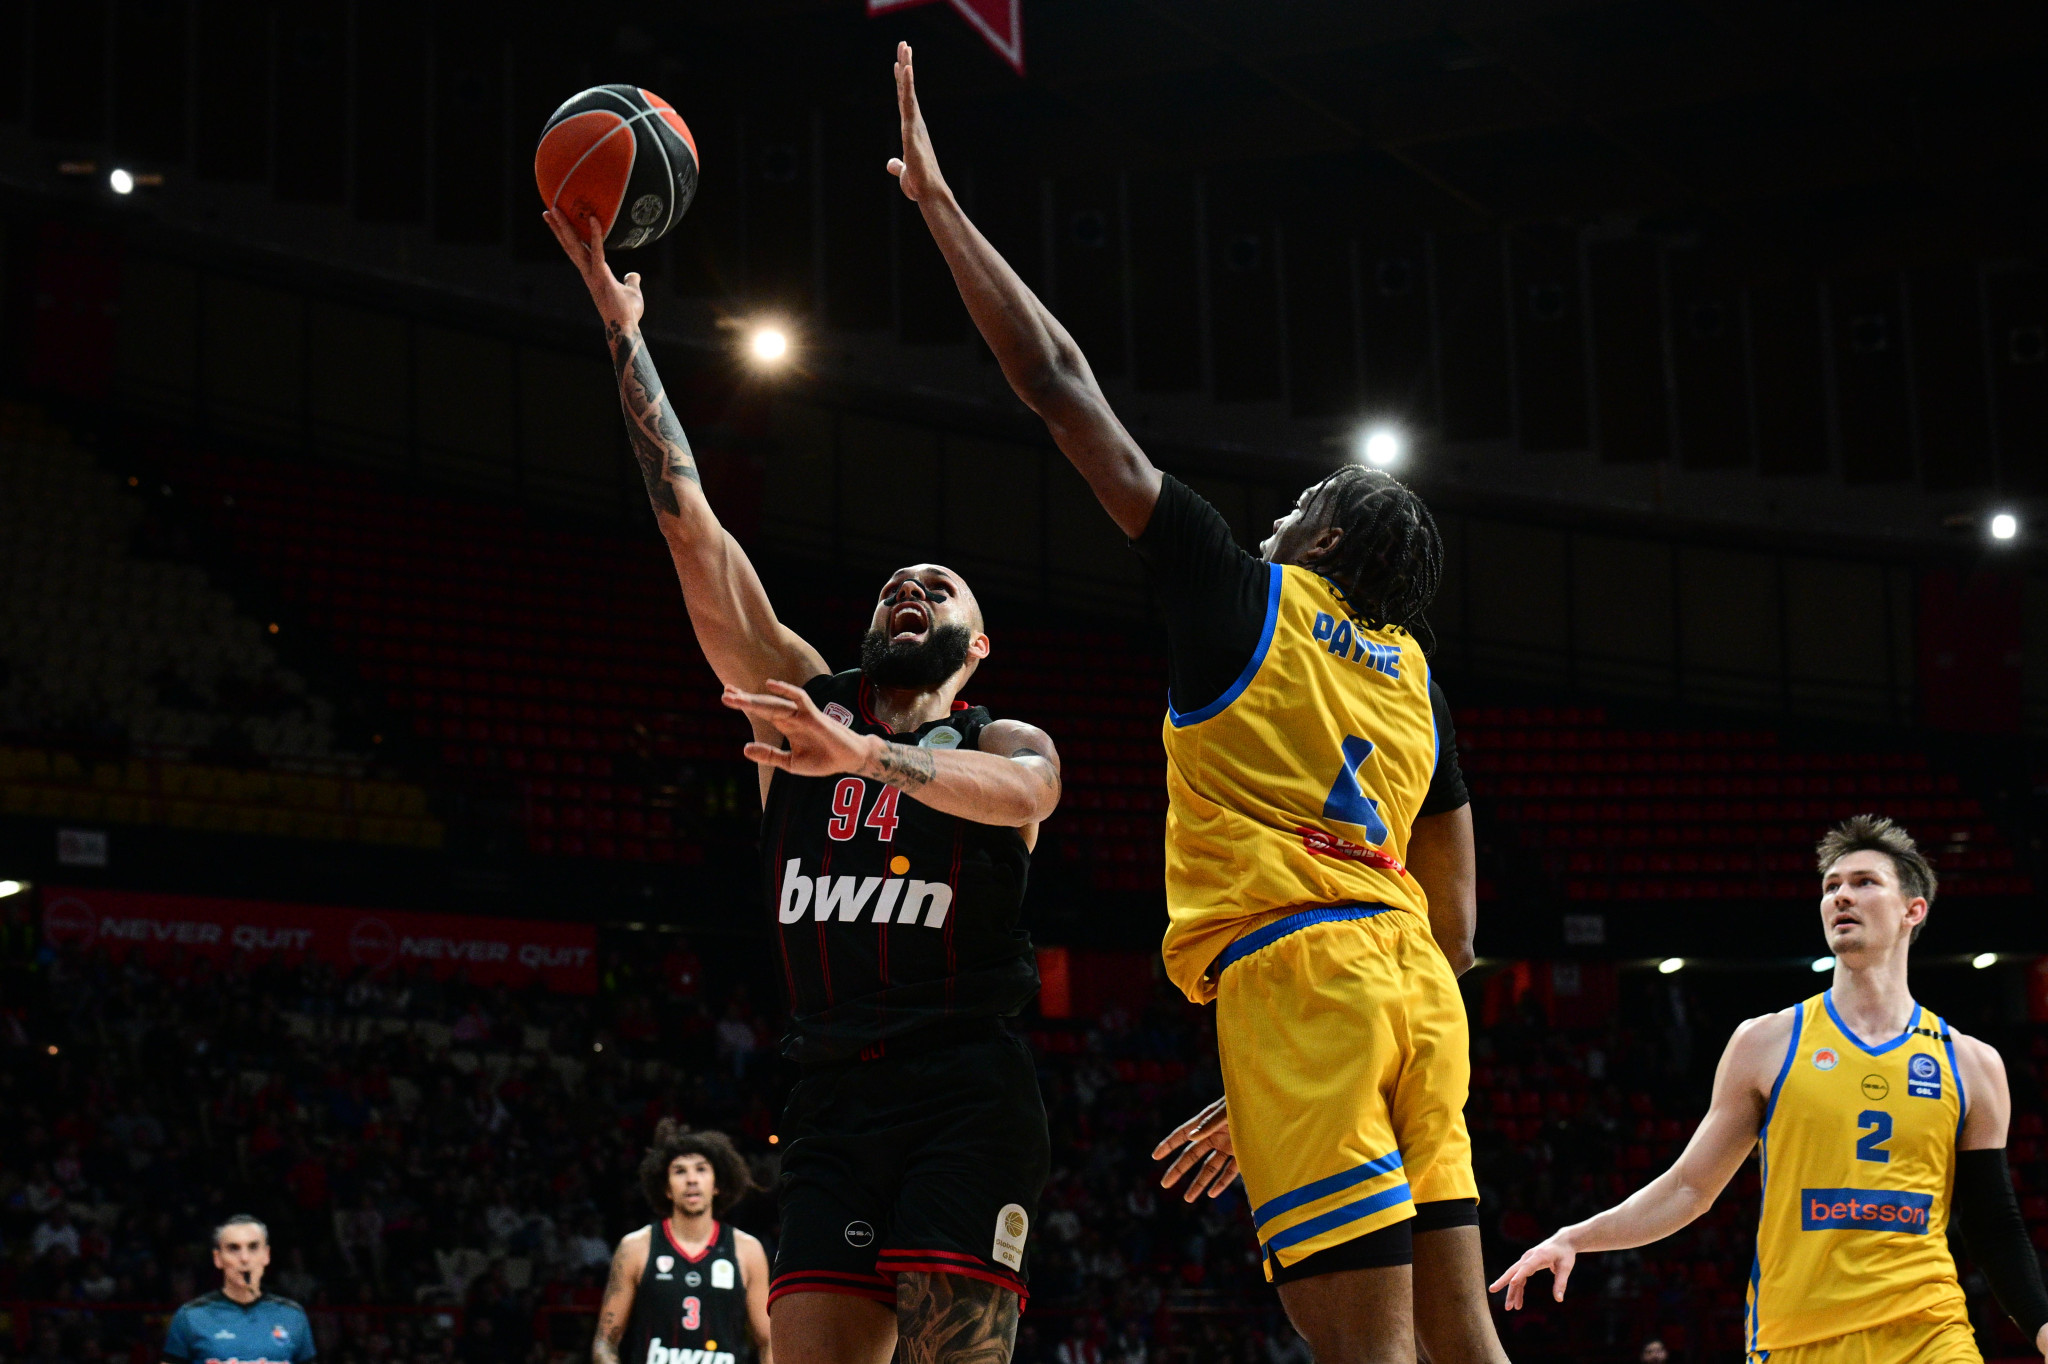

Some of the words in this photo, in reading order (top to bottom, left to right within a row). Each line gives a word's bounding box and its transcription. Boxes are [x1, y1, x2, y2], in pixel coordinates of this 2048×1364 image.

[828, 777, 901, 842] 94
[1322, 733, 1389, 847] 4
[779, 855, 953, 929] bwin
[100, 916, 224, 945] NEVER
[230, 923, 313, 951] QUIT
[400, 936, 510, 963] NEVER
[517, 943, 594, 970] QUIT
[1856, 1109, 1893, 1163] 2
[1810, 1198, 1925, 1226] betsson
[682, 1296, 701, 1330] 3
